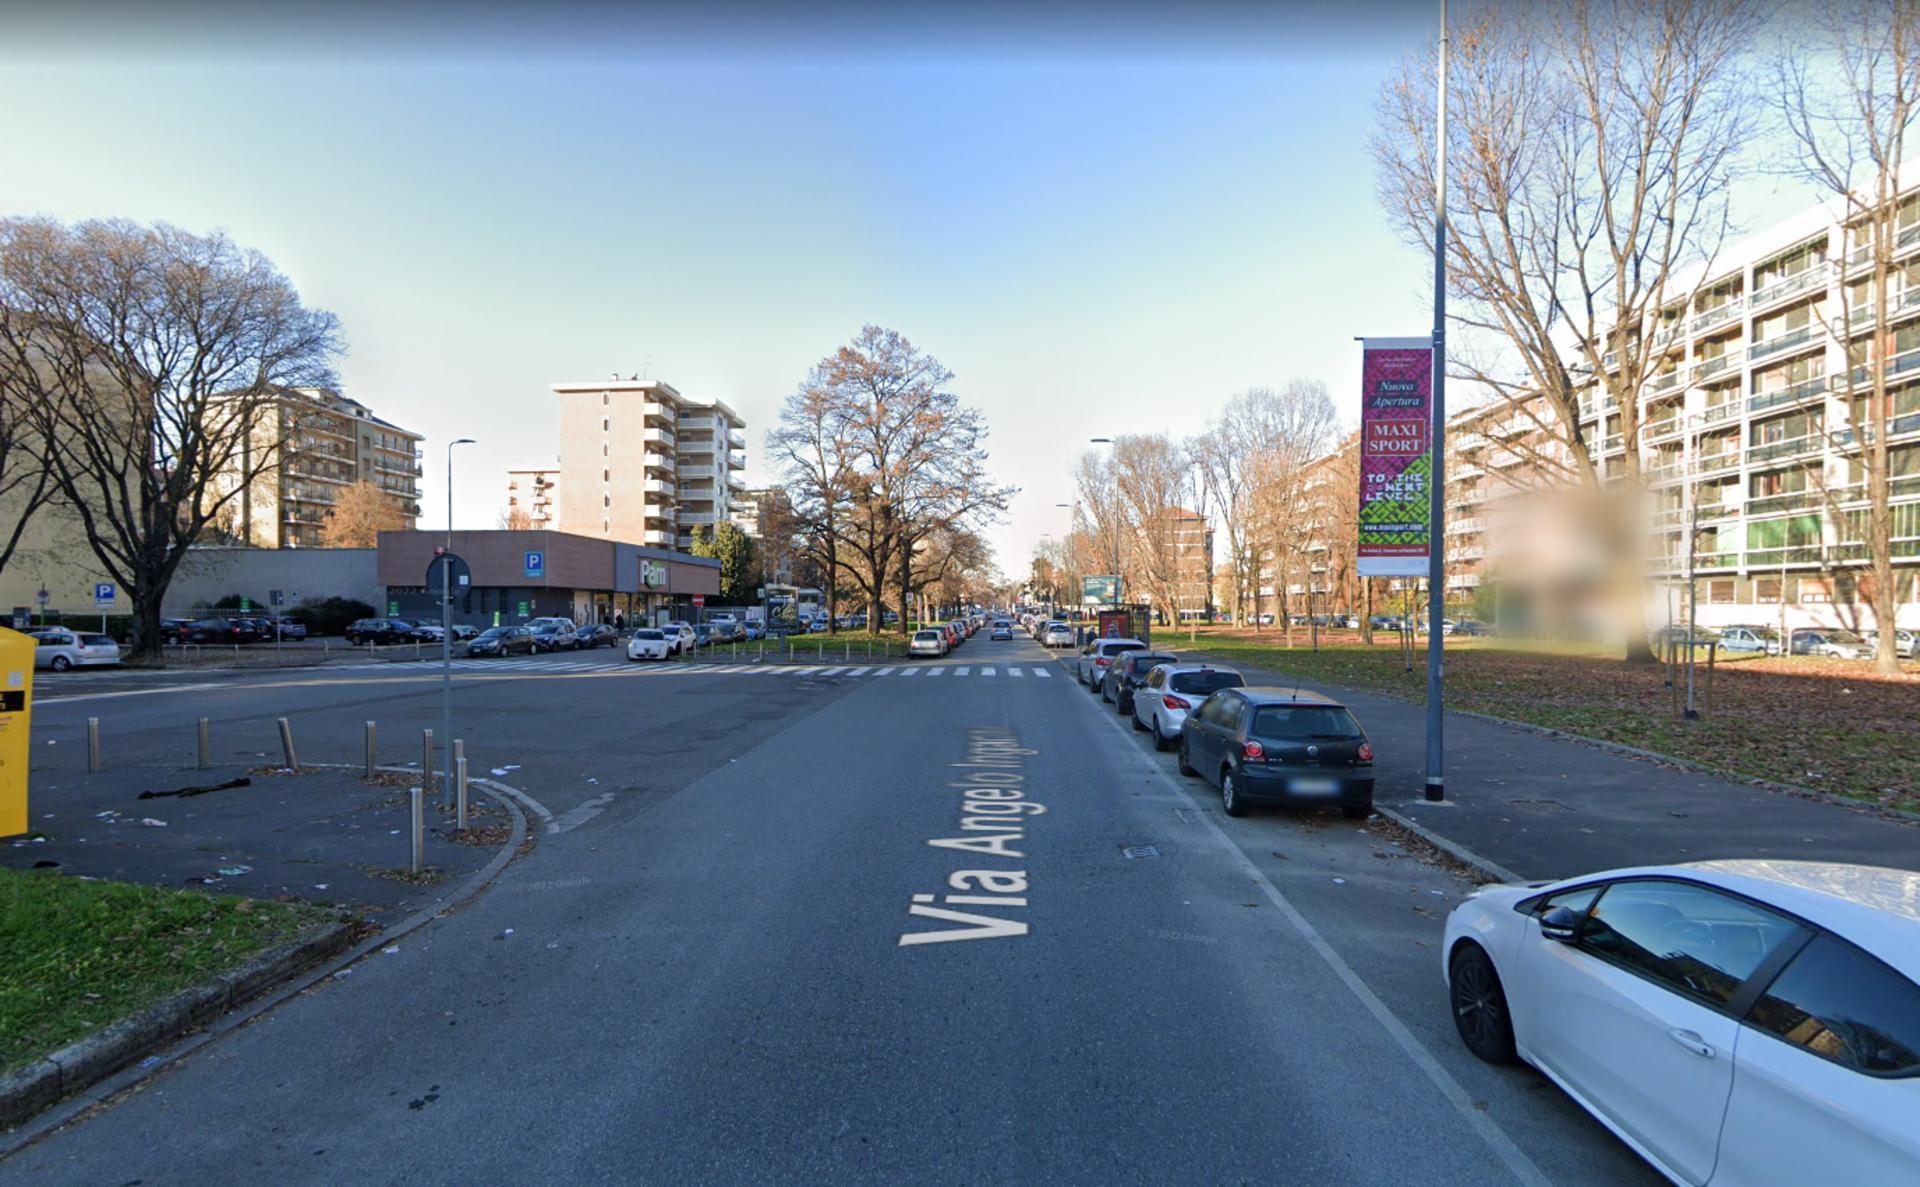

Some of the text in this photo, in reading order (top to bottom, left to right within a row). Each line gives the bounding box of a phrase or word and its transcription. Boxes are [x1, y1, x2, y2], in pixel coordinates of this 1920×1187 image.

[1380, 381, 1414, 391] Nuova
[1373, 396, 1420, 408] Apertura
[1374, 424, 1418, 436] MAXI
[1369, 440, 1422, 452] SPORT
[1367, 473, 1424, 483] TO THE
[1385, 483, 1424, 492] NEXT
[1365, 492, 1414, 501] LEVEL
[640, 560, 667, 585] Pam
